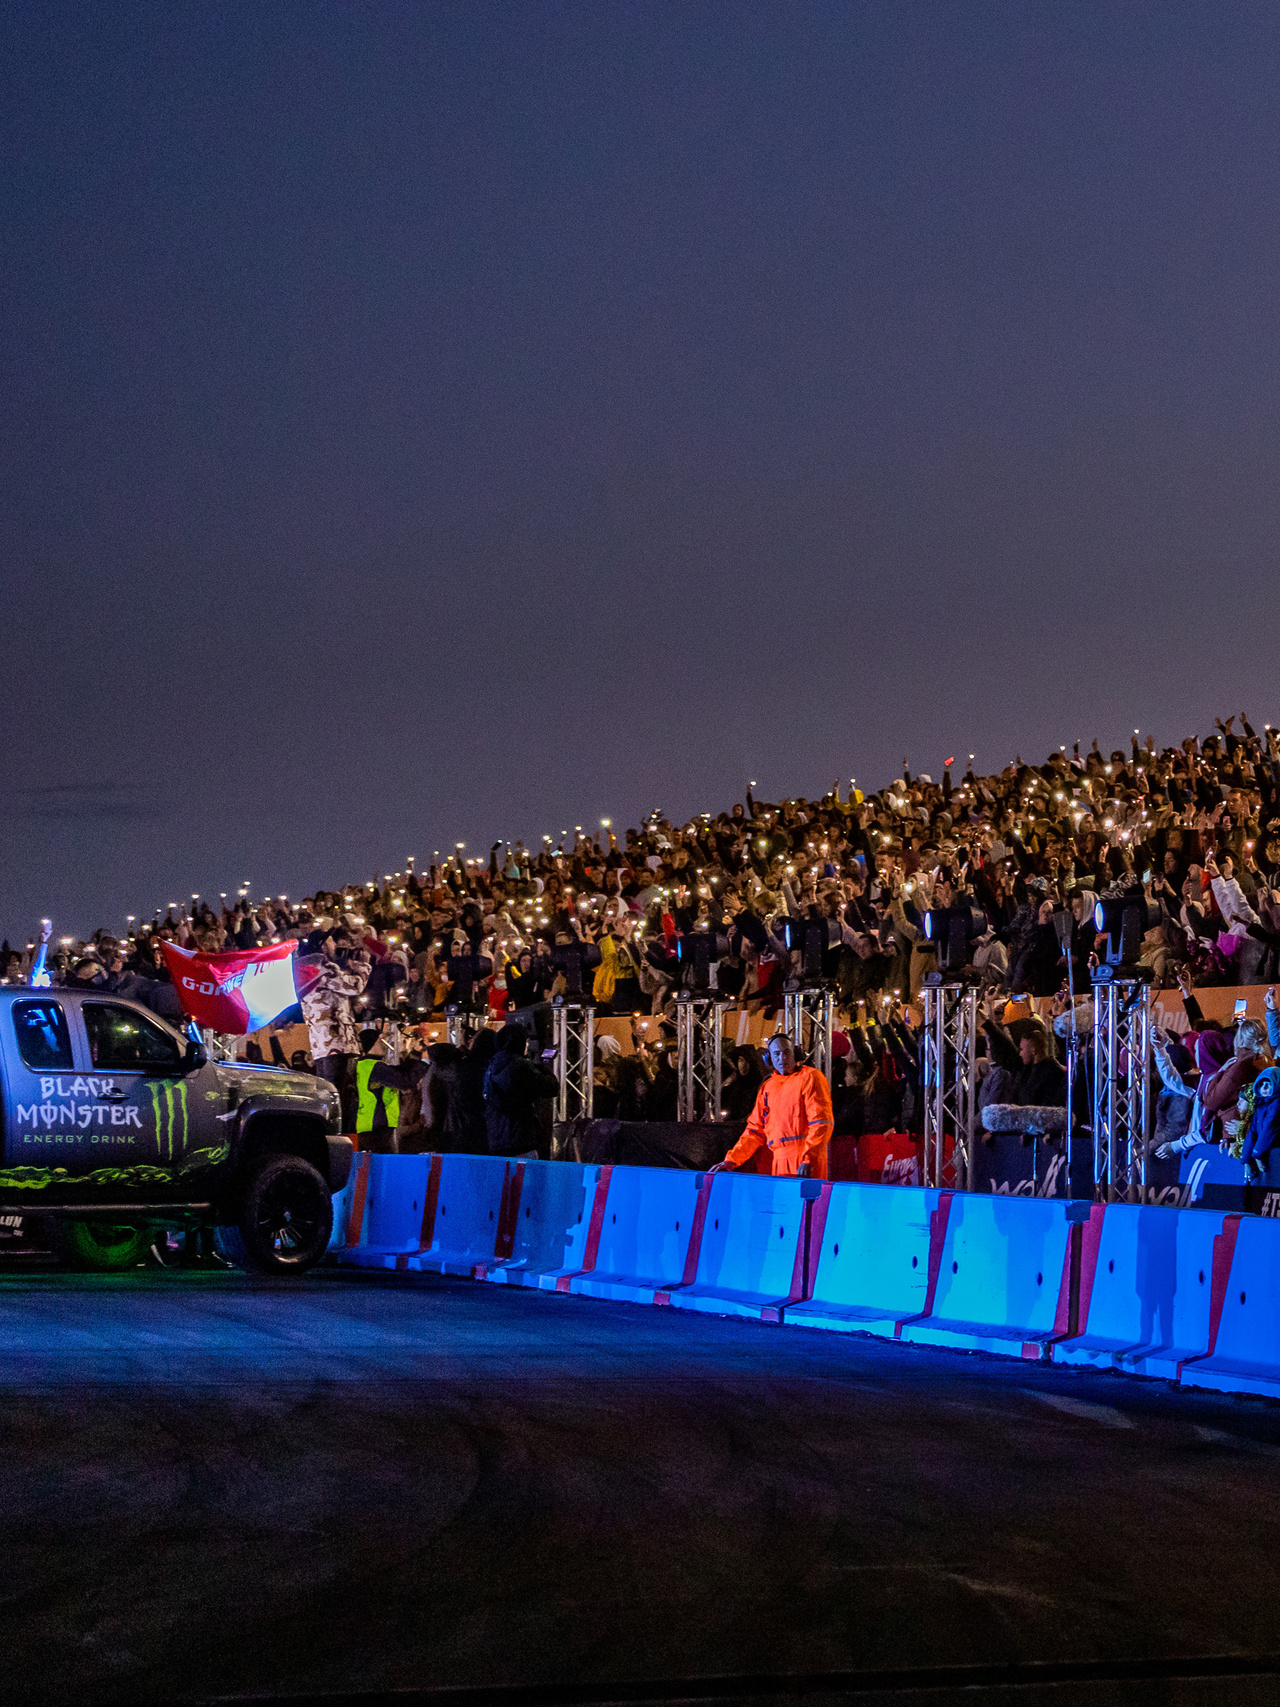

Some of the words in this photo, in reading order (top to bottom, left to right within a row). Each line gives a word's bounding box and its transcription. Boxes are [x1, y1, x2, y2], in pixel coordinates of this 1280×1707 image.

[17, 1100, 143, 1129] MONSTER
[24, 1134, 84, 1144] ENERGY
[91, 1135, 136, 1145] DRINK
